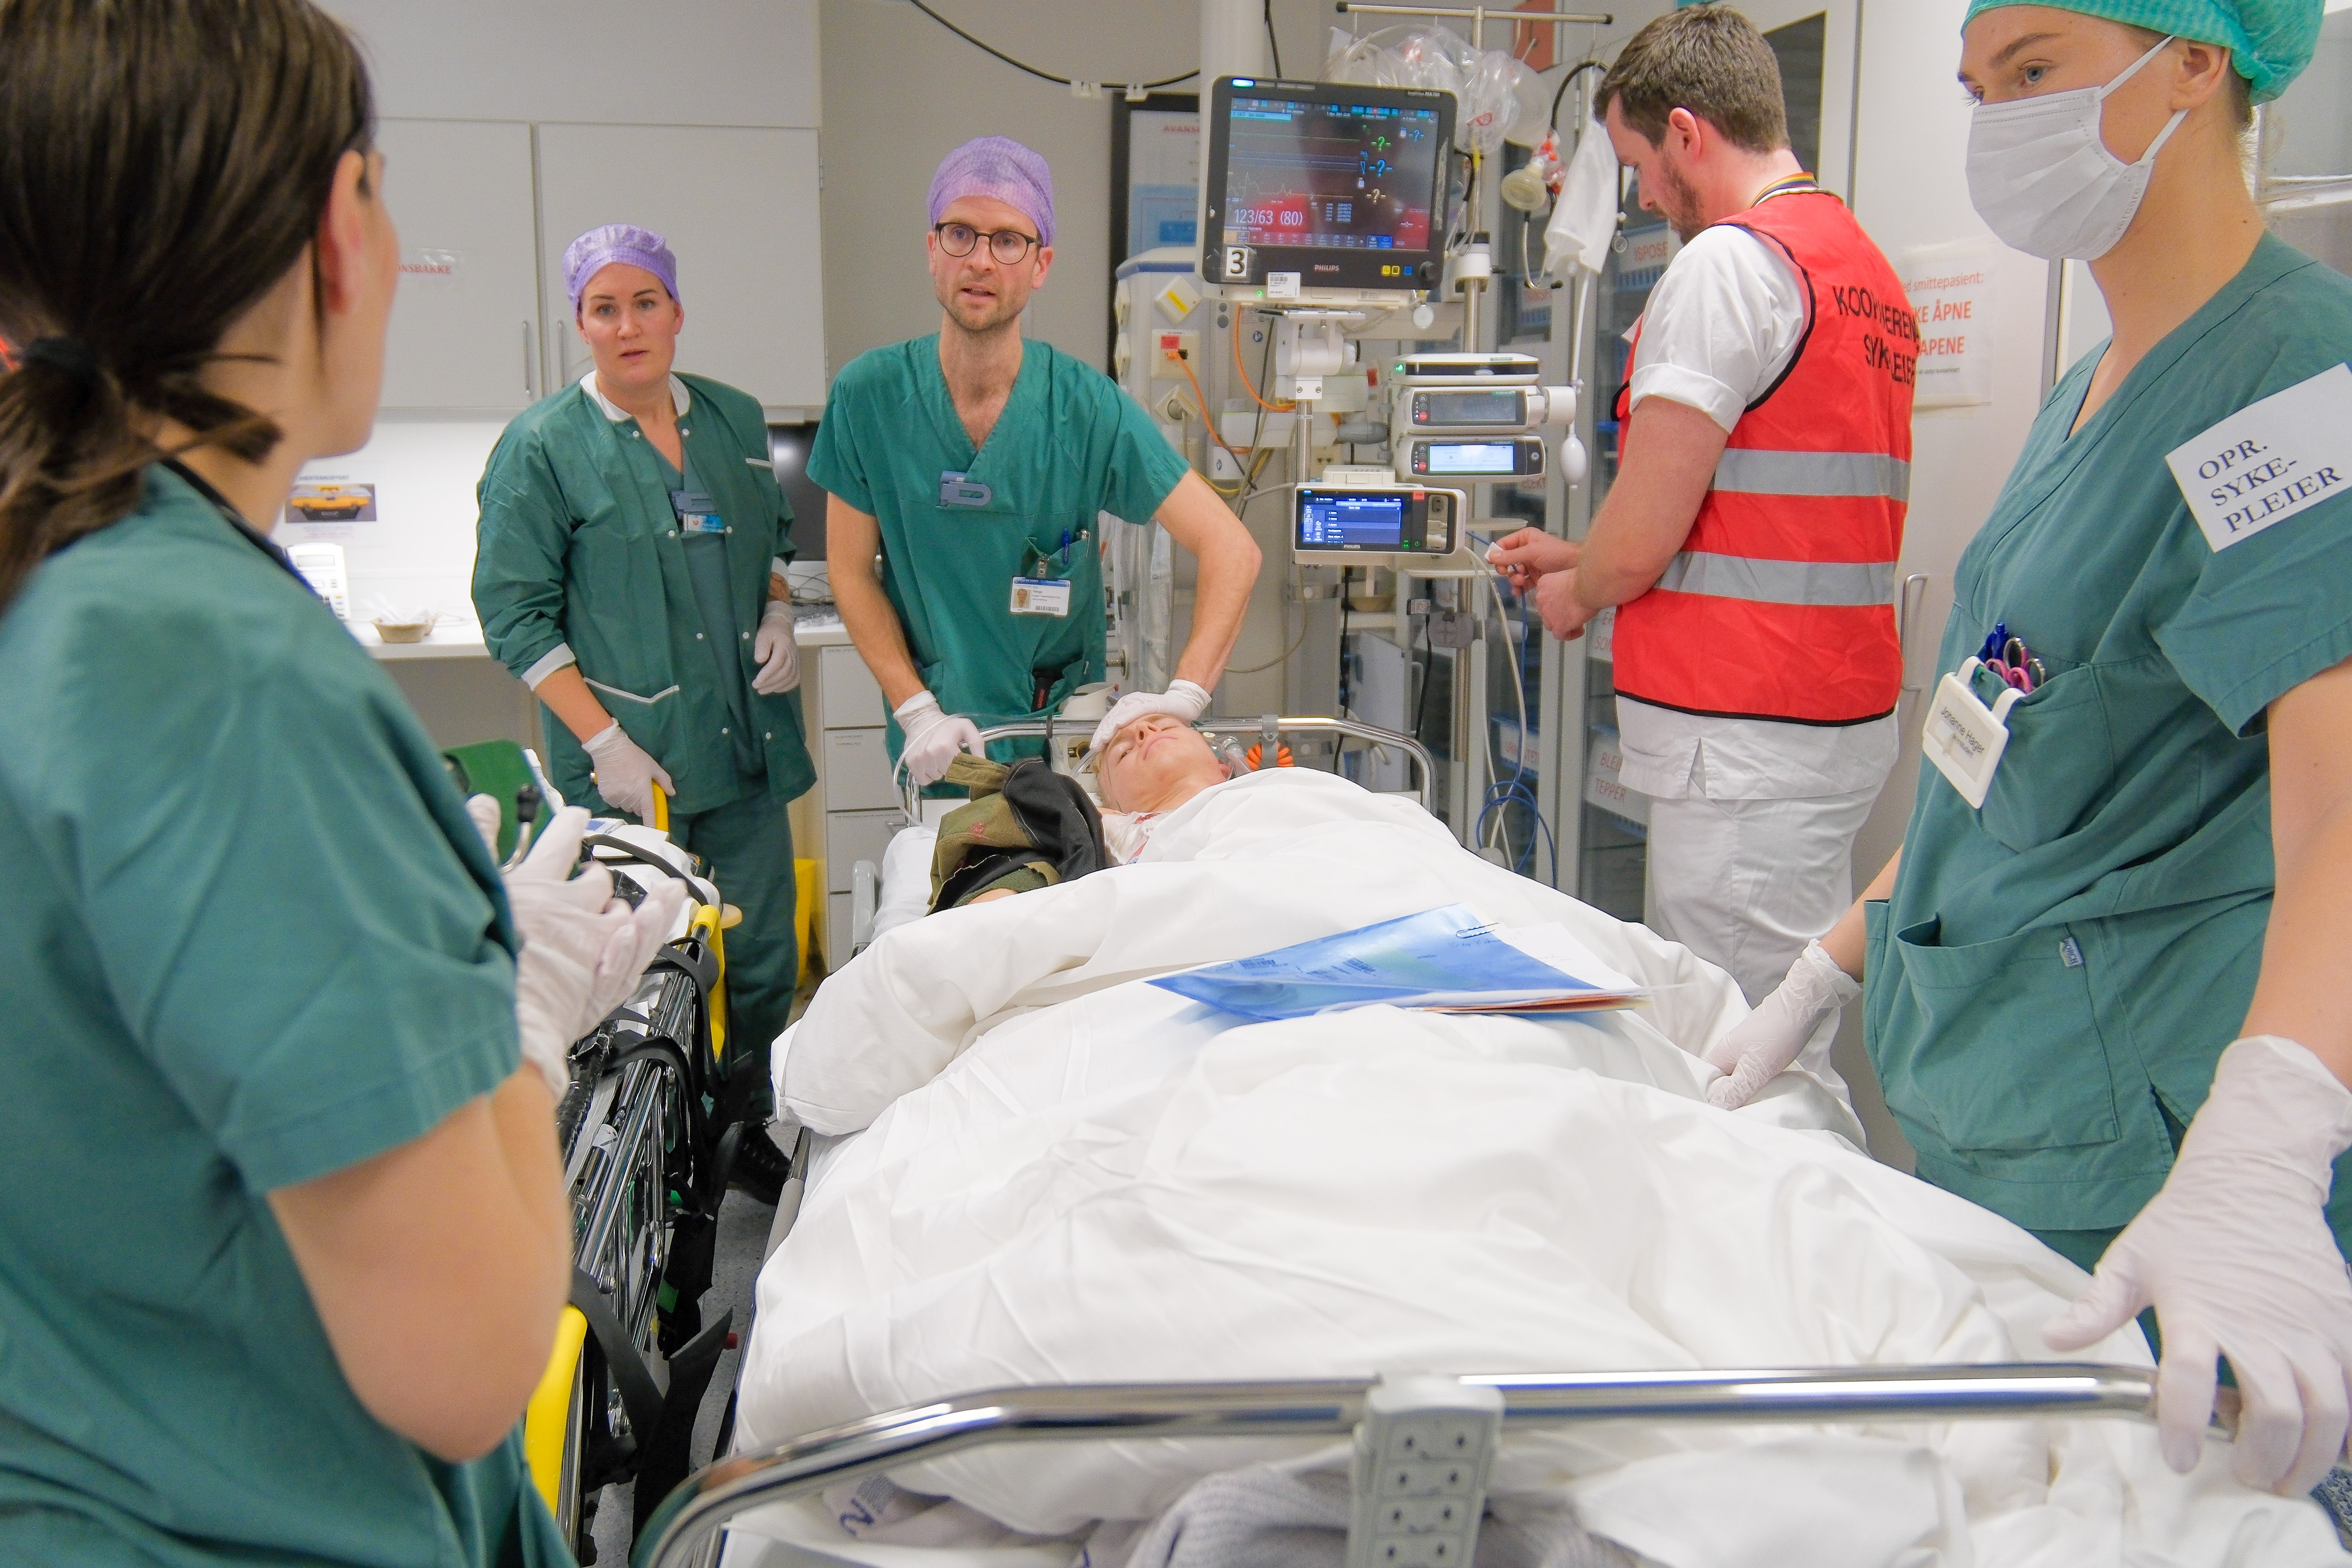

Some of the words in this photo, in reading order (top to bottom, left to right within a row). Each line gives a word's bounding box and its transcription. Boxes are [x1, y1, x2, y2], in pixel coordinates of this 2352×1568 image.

[1235, 209, 1273, 224] 123/63
[1280, 210, 1303, 226] (80)
[1230, 250, 1245, 274] 3
[1914, 272, 1984, 291] smittepasient:
[1933, 298, 1972, 322] ÅPNE
[1919, 336, 1965, 356] APENE
[2198, 439, 2268, 480] OPR.
[2210, 457, 2297, 506] SYKE-
[2222, 466, 2343, 533] PLEIER
